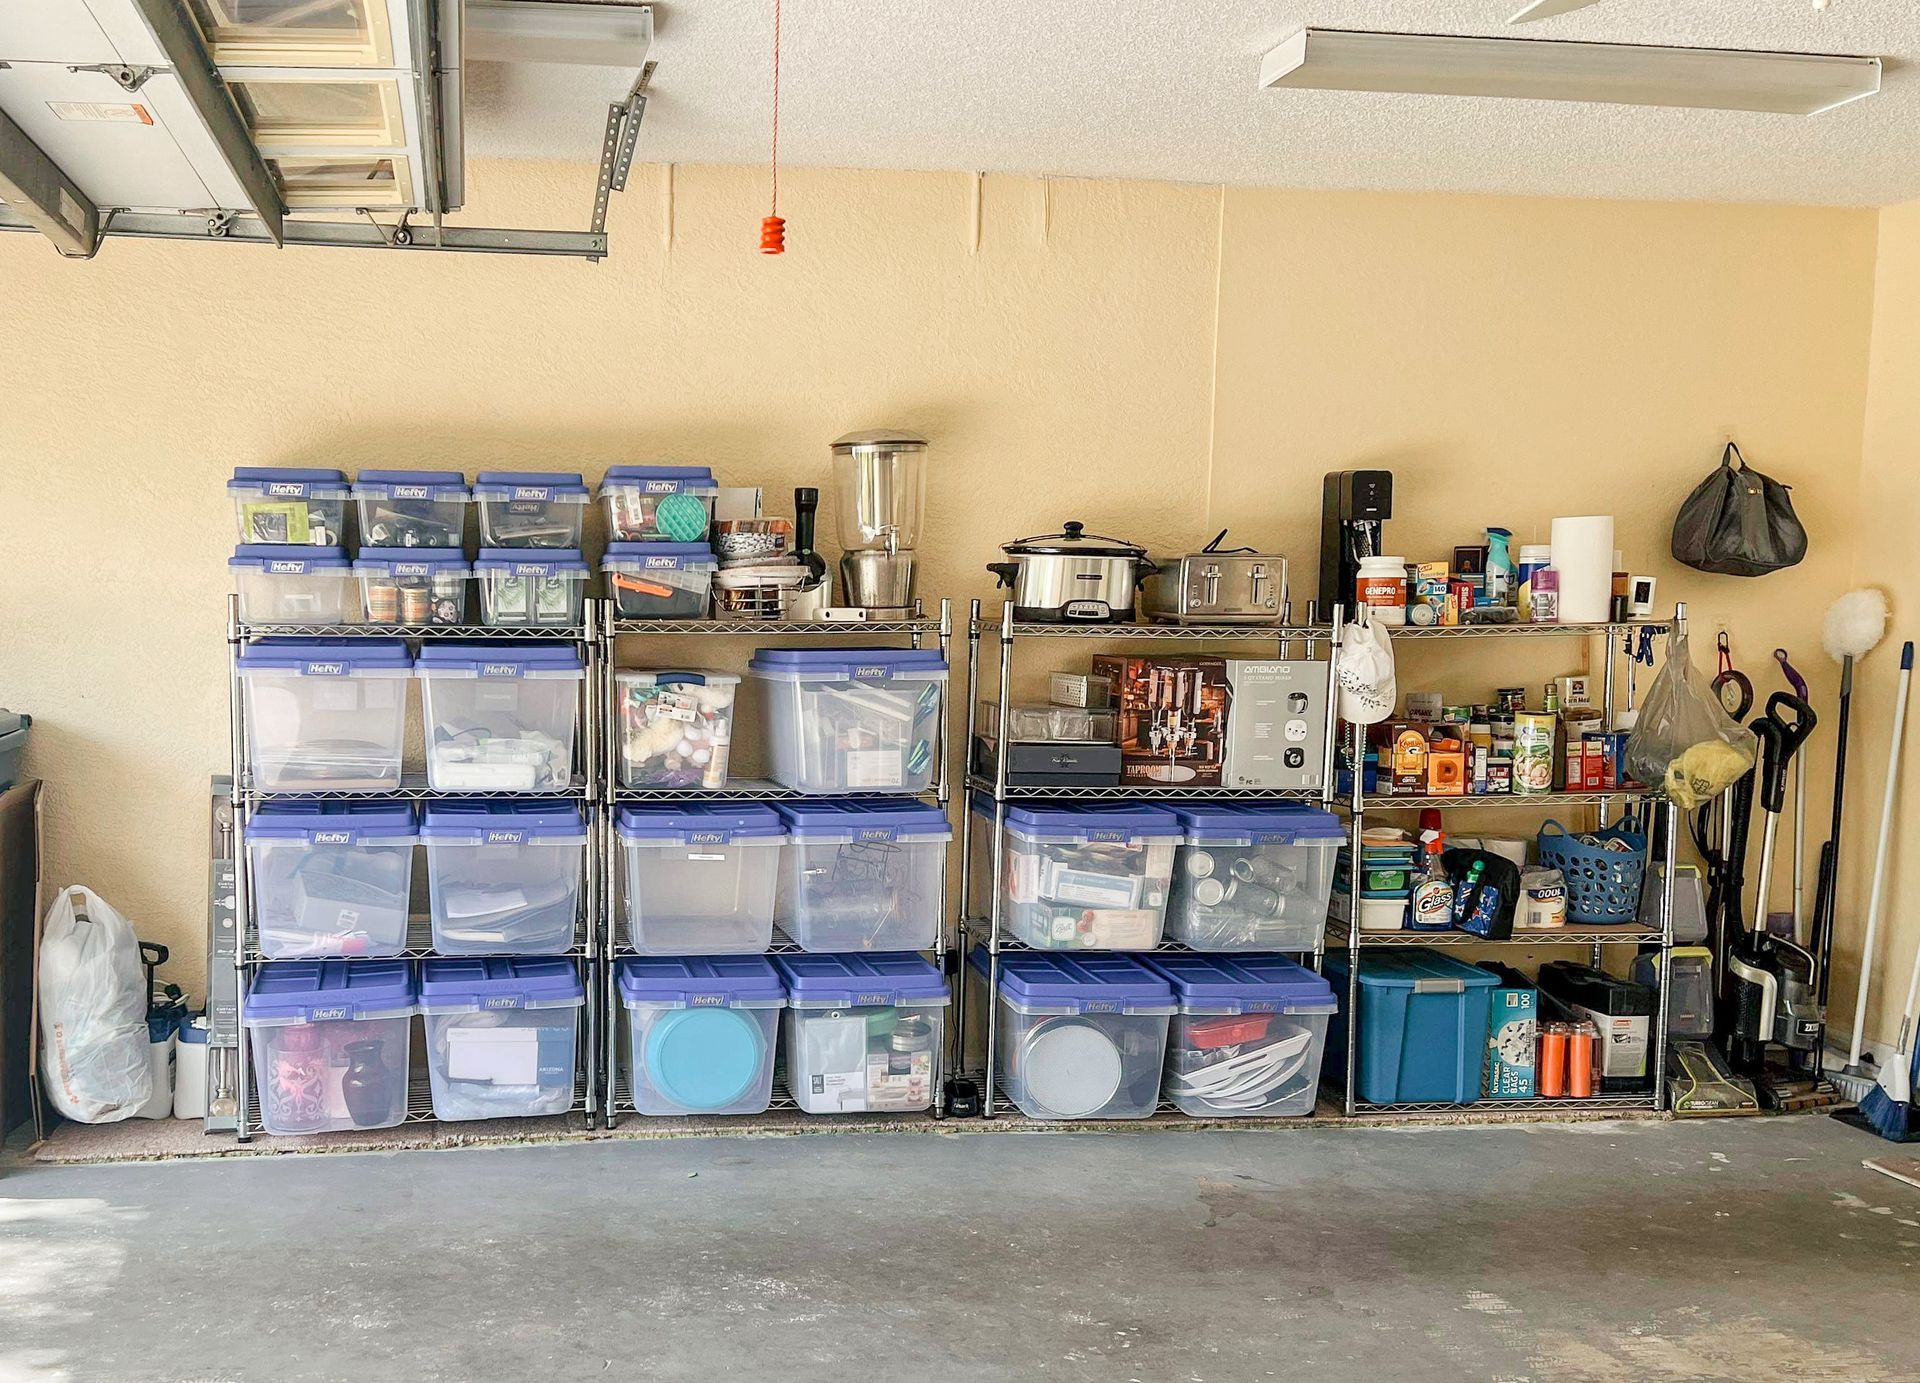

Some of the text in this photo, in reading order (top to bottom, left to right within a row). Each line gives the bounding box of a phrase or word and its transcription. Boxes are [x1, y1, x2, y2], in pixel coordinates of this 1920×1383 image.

[271, 484, 301, 495] Hefty
[648, 482, 676, 492] Hefty
[396, 488, 426, 497] Hefty
[517, 489, 546, 499] Hefty
[272, 562, 302, 572] Hefty
[648, 558, 676, 568] Hefty
[397, 564, 426, 575] Hefty
[518, 565, 548, 575] Hefty
[1365, 586, 1396, 594] GENEPRO
[310, 664, 341, 674] Hefty
[486, 665, 515, 675] Hefty
[857, 667, 885, 677] Hefty
[1126, 765, 1161, 774] TAPROOM
[318, 833, 348, 843] Hefty
[491, 832, 520, 842] Hefty
[693, 834, 721, 843] Hefty
[862, 831, 889, 840] Hefty
[1095, 832, 1123, 841] Hefty
[1419, 892, 1452, 912] Glass
[487, 998, 516, 1008] Hefty
[695, 996, 722, 1006] Hefty
[1521, 994, 1530, 1009] 100
[315, 1009, 344, 1019] Hefty
[1502, 1067, 1510, 1094] CLEAR
[1519, 1078, 1528, 1093] 45
